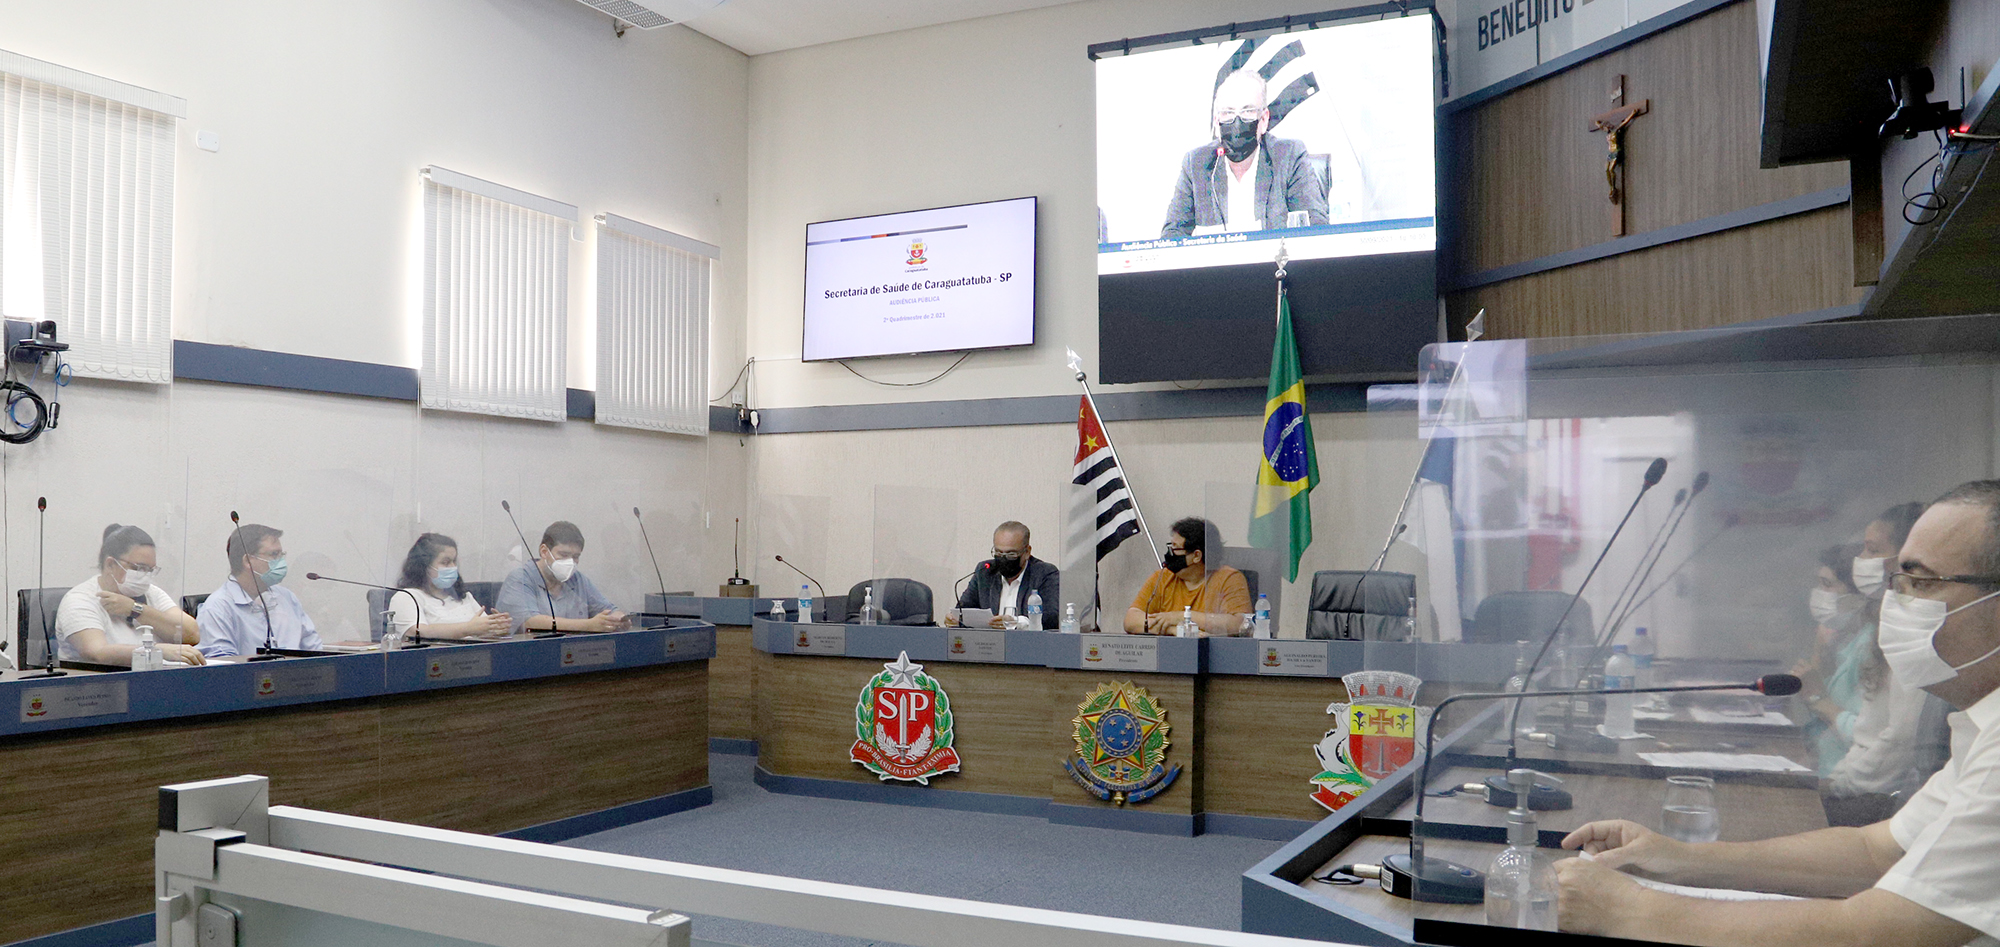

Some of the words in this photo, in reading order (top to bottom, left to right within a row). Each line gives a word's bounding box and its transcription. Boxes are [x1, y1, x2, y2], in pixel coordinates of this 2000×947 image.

[824, 286, 868, 299] Secretaria
[870, 284, 883, 294] de
[882, 281, 910, 294] Saúde
[911, 279, 923, 291] de
[924, 275, 992, 290] Caraguatatuba
[999, 272, 1013, 282] SP
[858, 742, 873, 753] PRO
[871, 751, 900, 776] BRASILIA
[903, 765, 928, 776] FIANT
